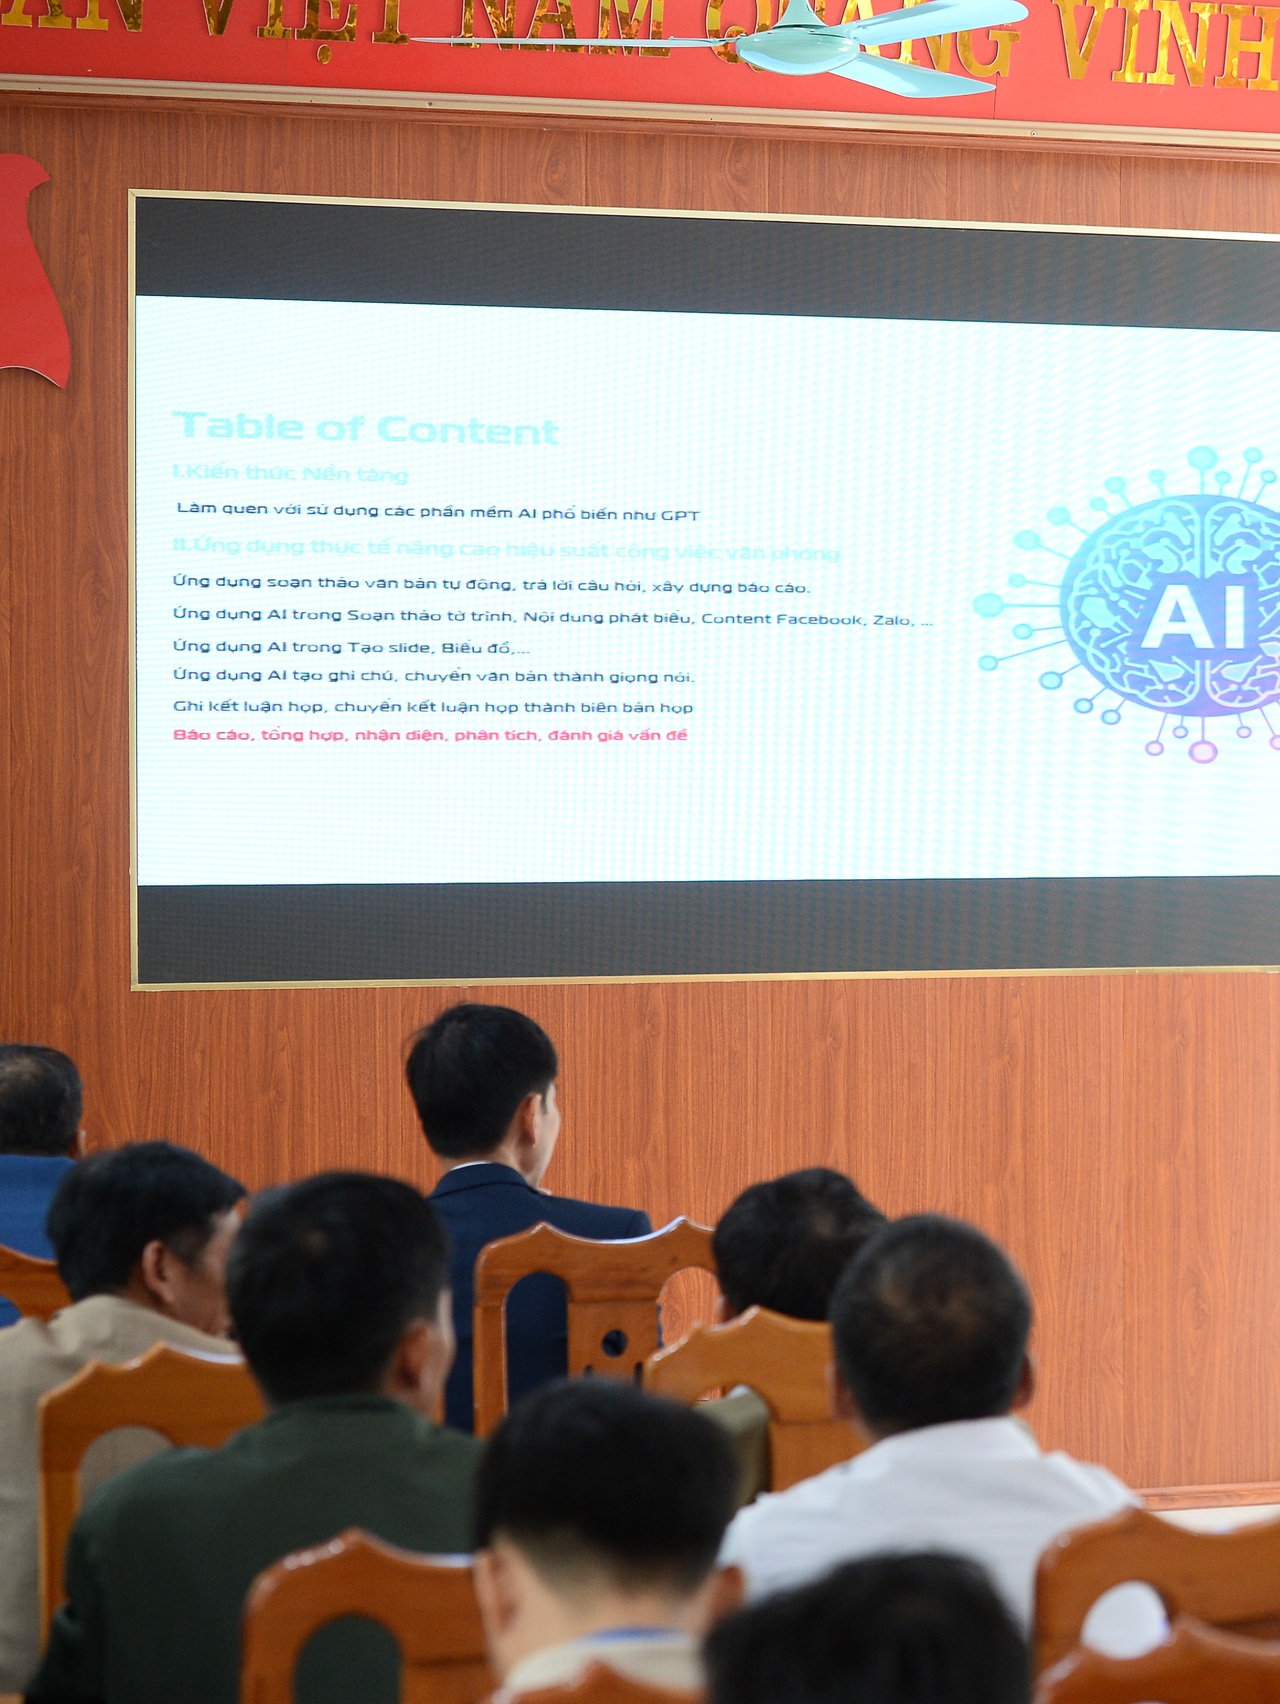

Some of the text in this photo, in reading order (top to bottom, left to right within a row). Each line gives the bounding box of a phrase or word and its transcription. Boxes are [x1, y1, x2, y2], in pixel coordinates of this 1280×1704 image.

[172, 410, 560, 445] Table of Content
[176, 500, 701, 523] Làm quen với sử dụng các phần mềm AI phổ biến như GPT
[460, 544, 500, 556] cao
[172, 571, 810, 596] Ứng dụng soạn thảo văn bản tự động, trả lời câu hỏi, xây dựng báo cáo.
[172, 604, 212, 622] Ứng
[215, 606, 263, 623] dụng
[266, 606, 288, 621] AI
[291, 607, 343, 624] trong
[347, 607, 396, 623] Soạn
[400, 607, 442, 622] thảo
[446, 609, 466, 623] tờ
[470, 608, 517, 624] trình,
[523, 609, 555, 625] Nội
[559, 610, 605, 626] dung
[608, 611, 649, 626] phát
[653, 609, 696, 626] biểu,
[701, 611, 772, 626] Content
[776, 611, 868, 627] Facebook,
[873, 612, 915, 628] Zalo,
[1140, 584, 1245, 649] AI
[172, 636, 212, 655] Ứng
[215, 639, 264, 655] dụng
[267, 640, 288, 653] AI
[291, 640, 343, 656] trong
[347, 639, 385, 655] Tạo
[388, 641, 436, 656] slide,
[441, 639, 483, 655] Biểu
[172, 664, 695, 685] Ứng dụng AI tạo ghi chú, chuyển văn bản thành giọng nói.
[172, 697, 695, 716] Ghi kết luận họp, chuyển kết luận họp thành biên bản họp
[173, 724, 688, 744] Báo cáo, tổng hợp, nhận diện, phân tích, đánh giá vấn đề
